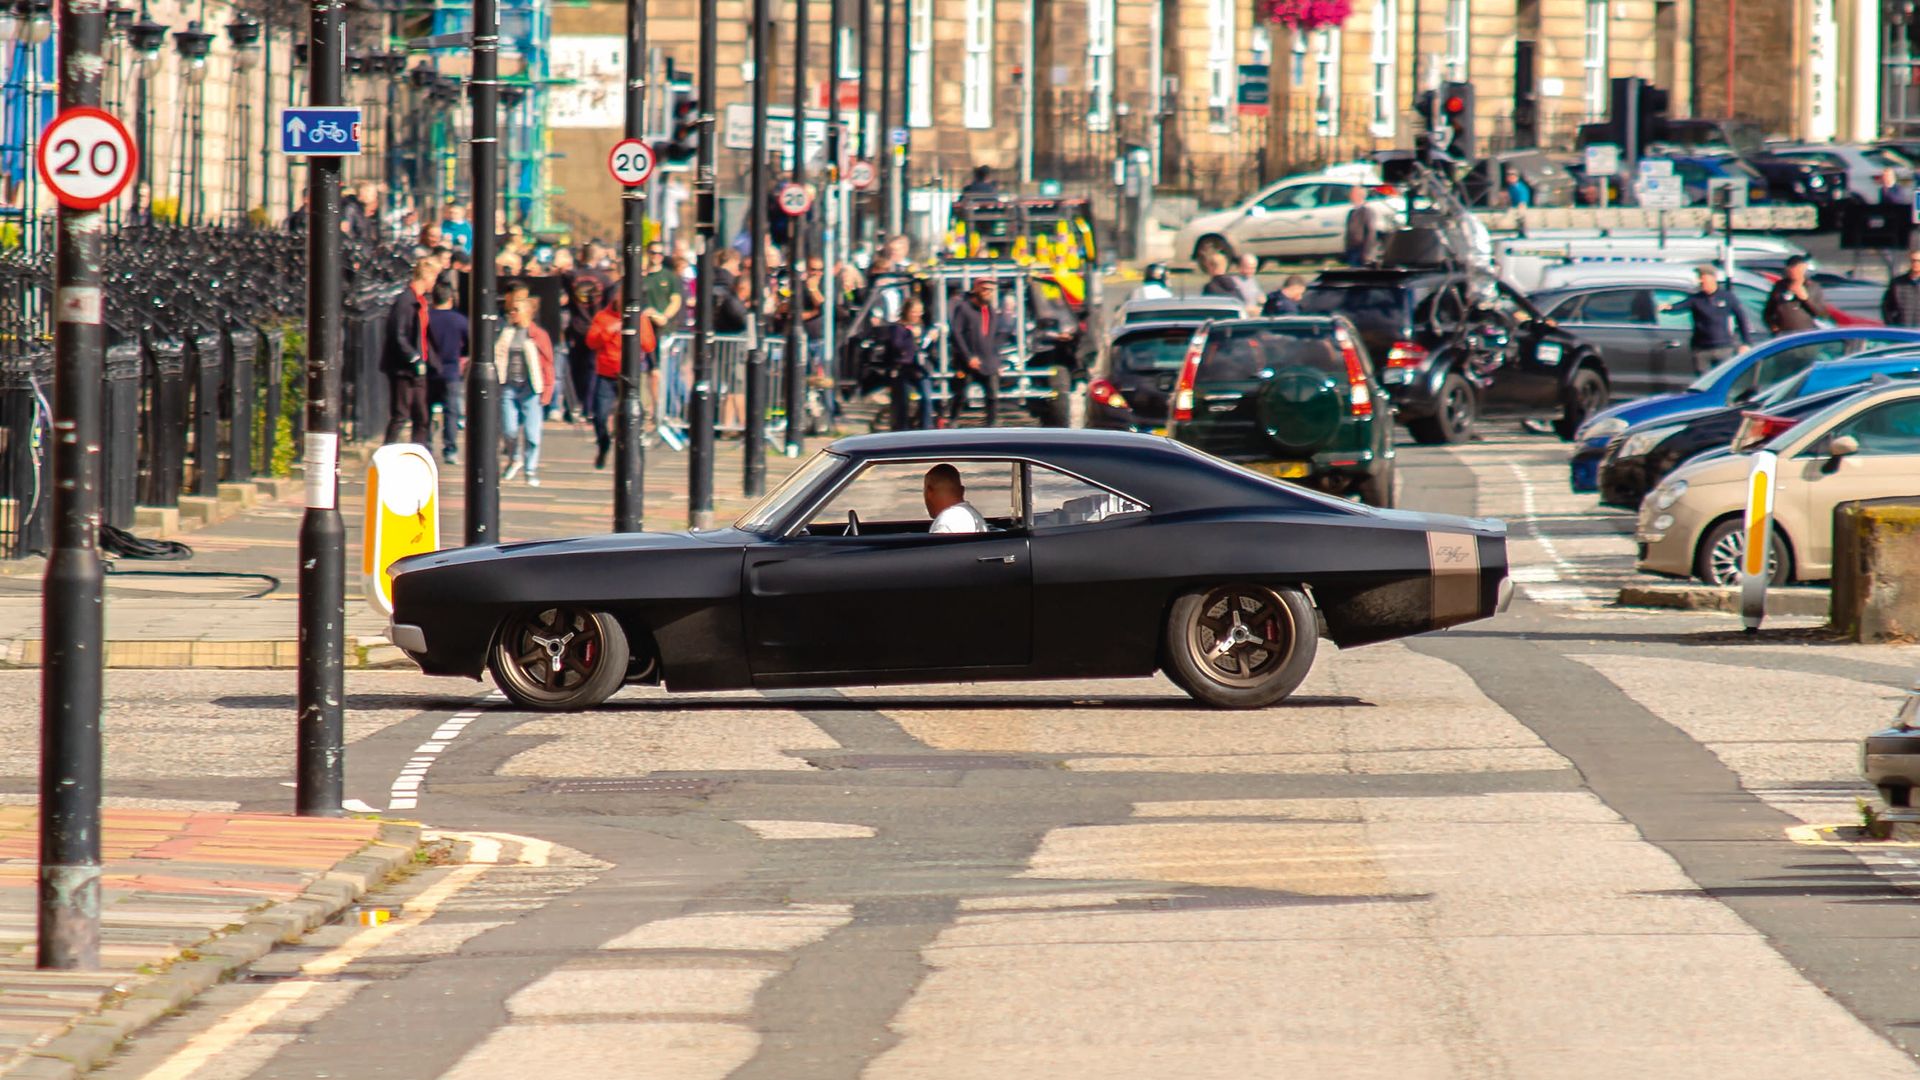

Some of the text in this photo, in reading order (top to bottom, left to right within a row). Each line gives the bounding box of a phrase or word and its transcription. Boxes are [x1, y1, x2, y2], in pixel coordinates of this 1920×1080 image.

[55, 138, 118, 177] 20
[616, 153, 647, 171] 20
[785, 193, 805, 207] 20
